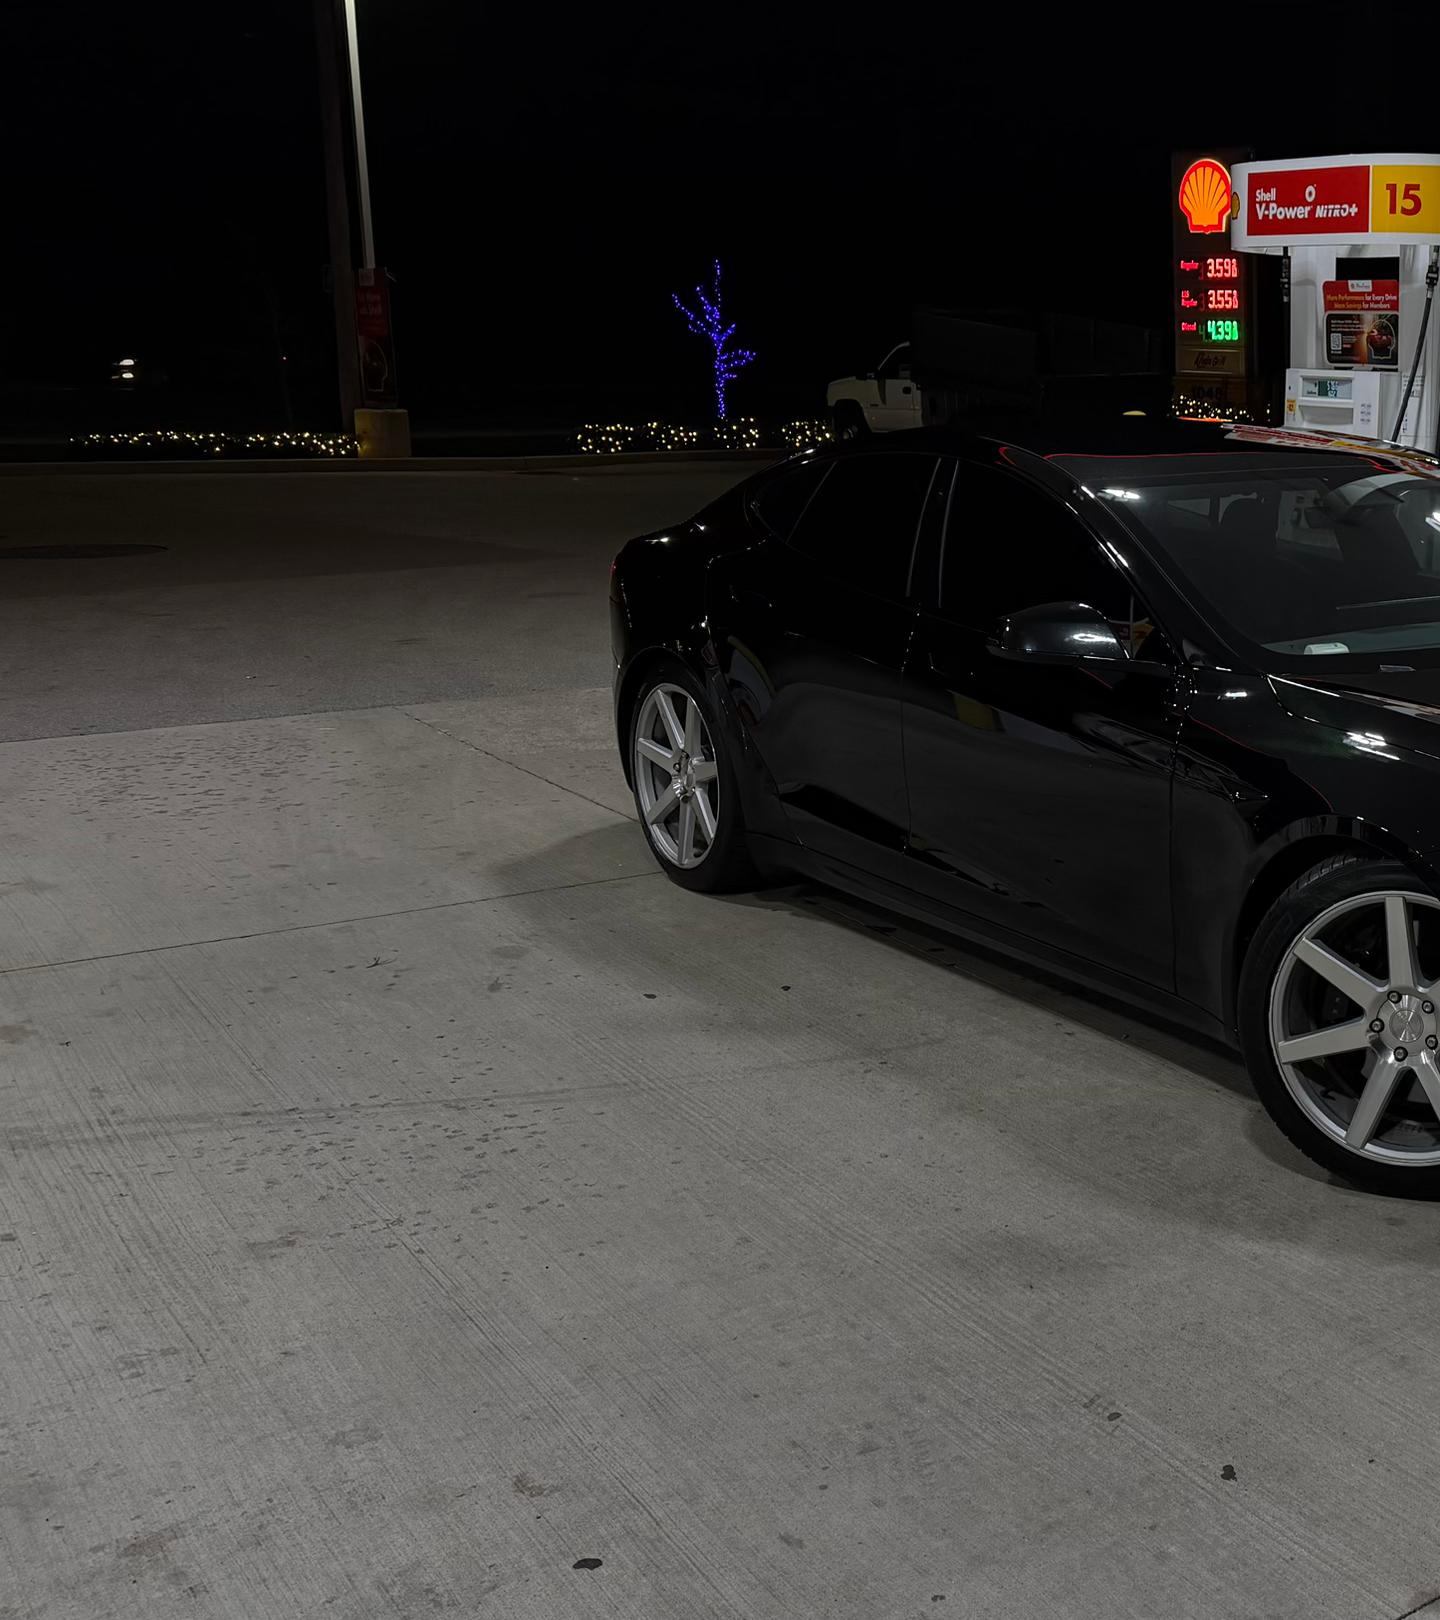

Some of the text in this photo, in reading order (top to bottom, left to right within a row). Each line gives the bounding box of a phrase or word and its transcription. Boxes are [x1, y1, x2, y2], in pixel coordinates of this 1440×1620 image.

[1255, 187, 1276, 202] Shell
[1385, 183, 1422, 216] 15
[1255, 203, 1311, 220] V-Power
